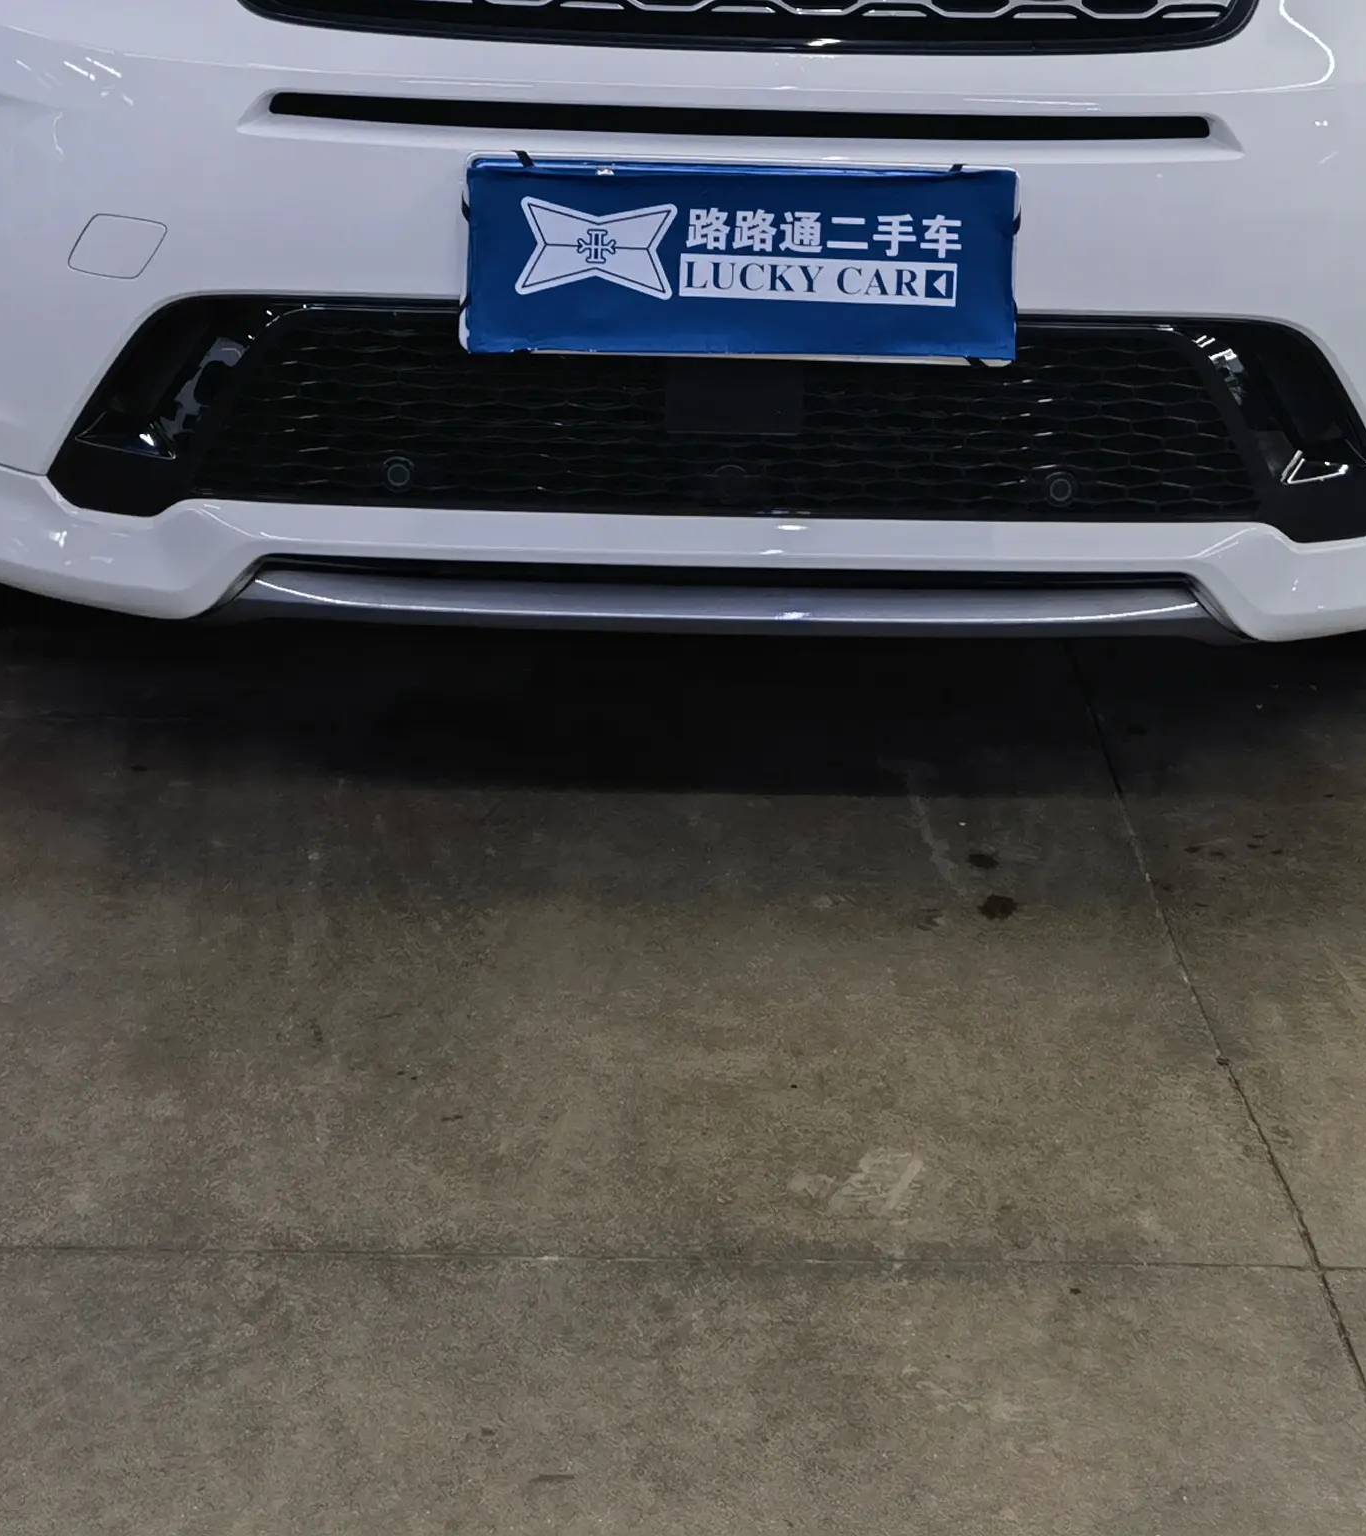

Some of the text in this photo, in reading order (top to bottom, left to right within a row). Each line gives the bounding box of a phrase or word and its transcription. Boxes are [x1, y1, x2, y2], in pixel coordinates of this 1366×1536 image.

[685, 208, 963, 259] 路路通二手车
[682, 261, 920, 297] LUCKY CAR
